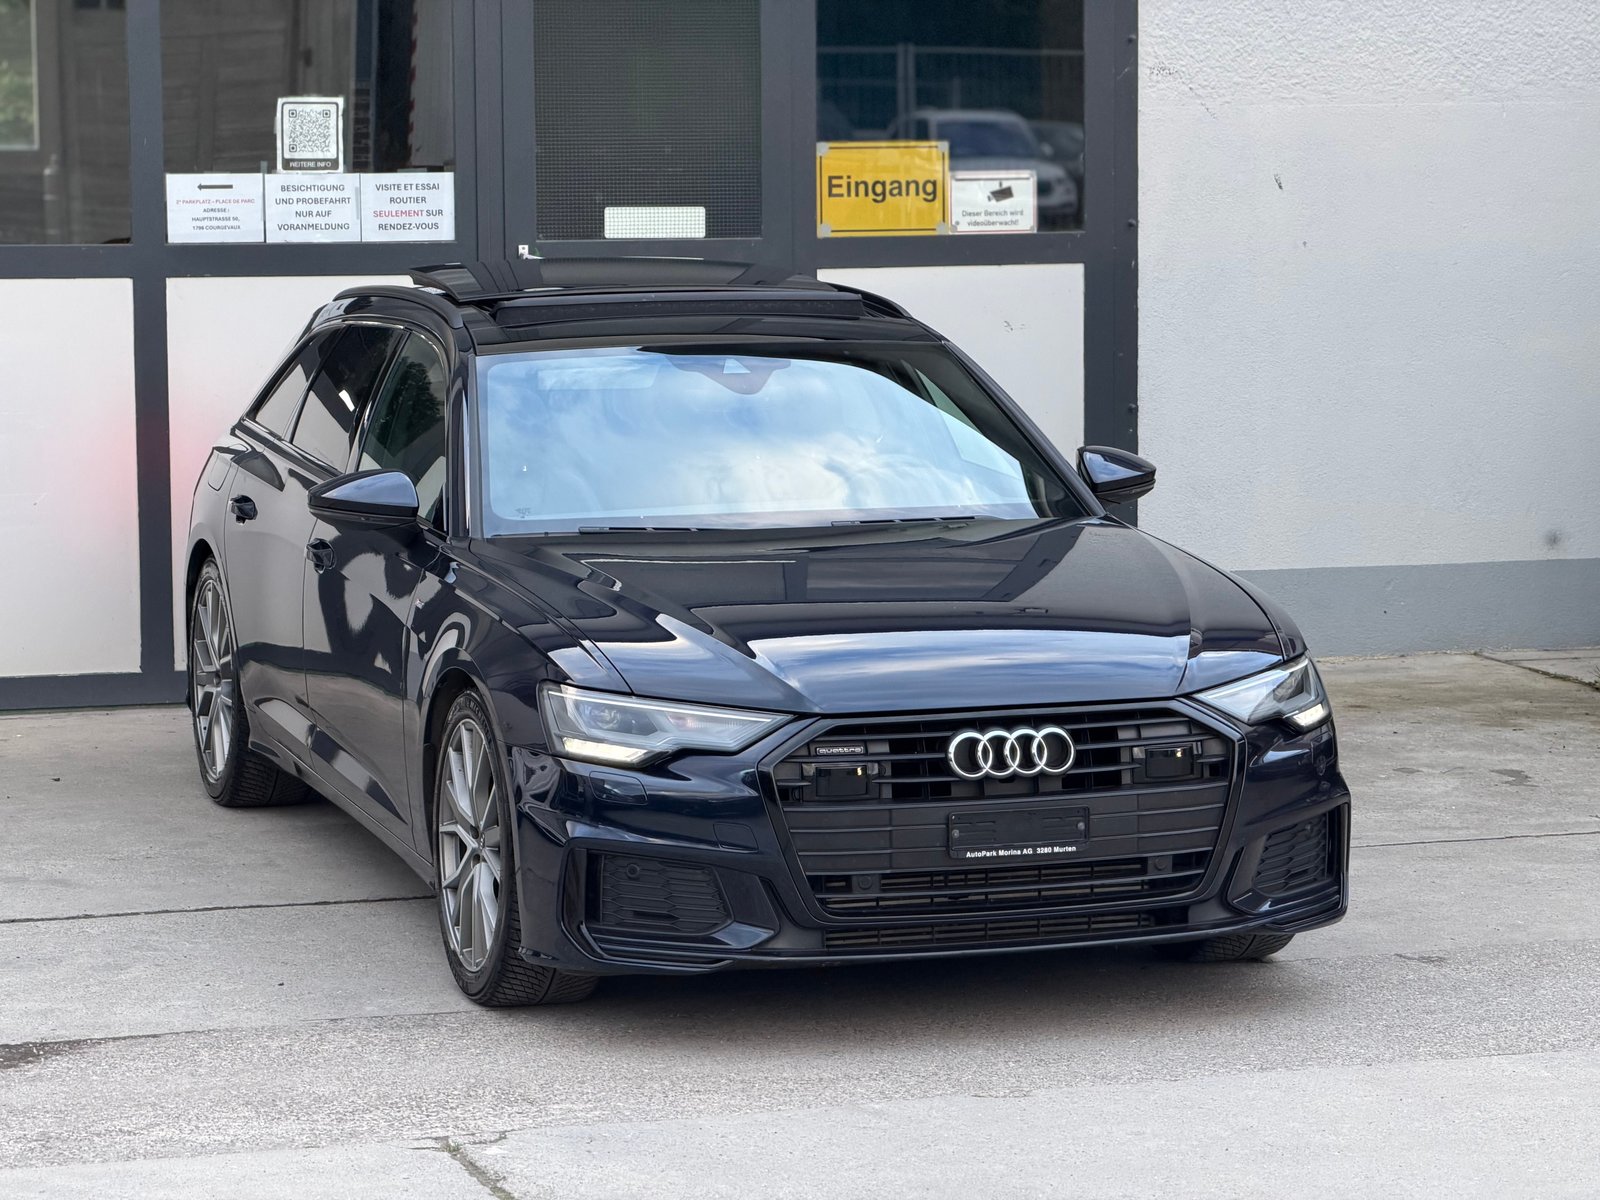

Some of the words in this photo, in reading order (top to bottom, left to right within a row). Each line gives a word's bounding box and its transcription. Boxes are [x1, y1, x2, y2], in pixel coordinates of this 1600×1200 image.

[280, 184, 345, 192] BESICHTIGUNG
[375, 183, 402, 191] VISITE
[403, 183, 414, 191] ET
[415, 183, 440, 191] ESSAI
[827, 175, 938, 203] Eingang
[296, 197, 351, 205] PROBEFAHRT
[389, 196, 427, 204] ROUTIER
[315, 210, 332, 218] AUF
[961, 209, 982, 217] Dieser
[983, 209, 1008, 217] Bereich
[1009, 208, 1024, 216] wird
[277, 223, 350, 231] VORANMELDUNG
[378, 222, 440, 231] RENDEZ-VOUS
[967, 219, 1019, 227] videoüberwacht!
